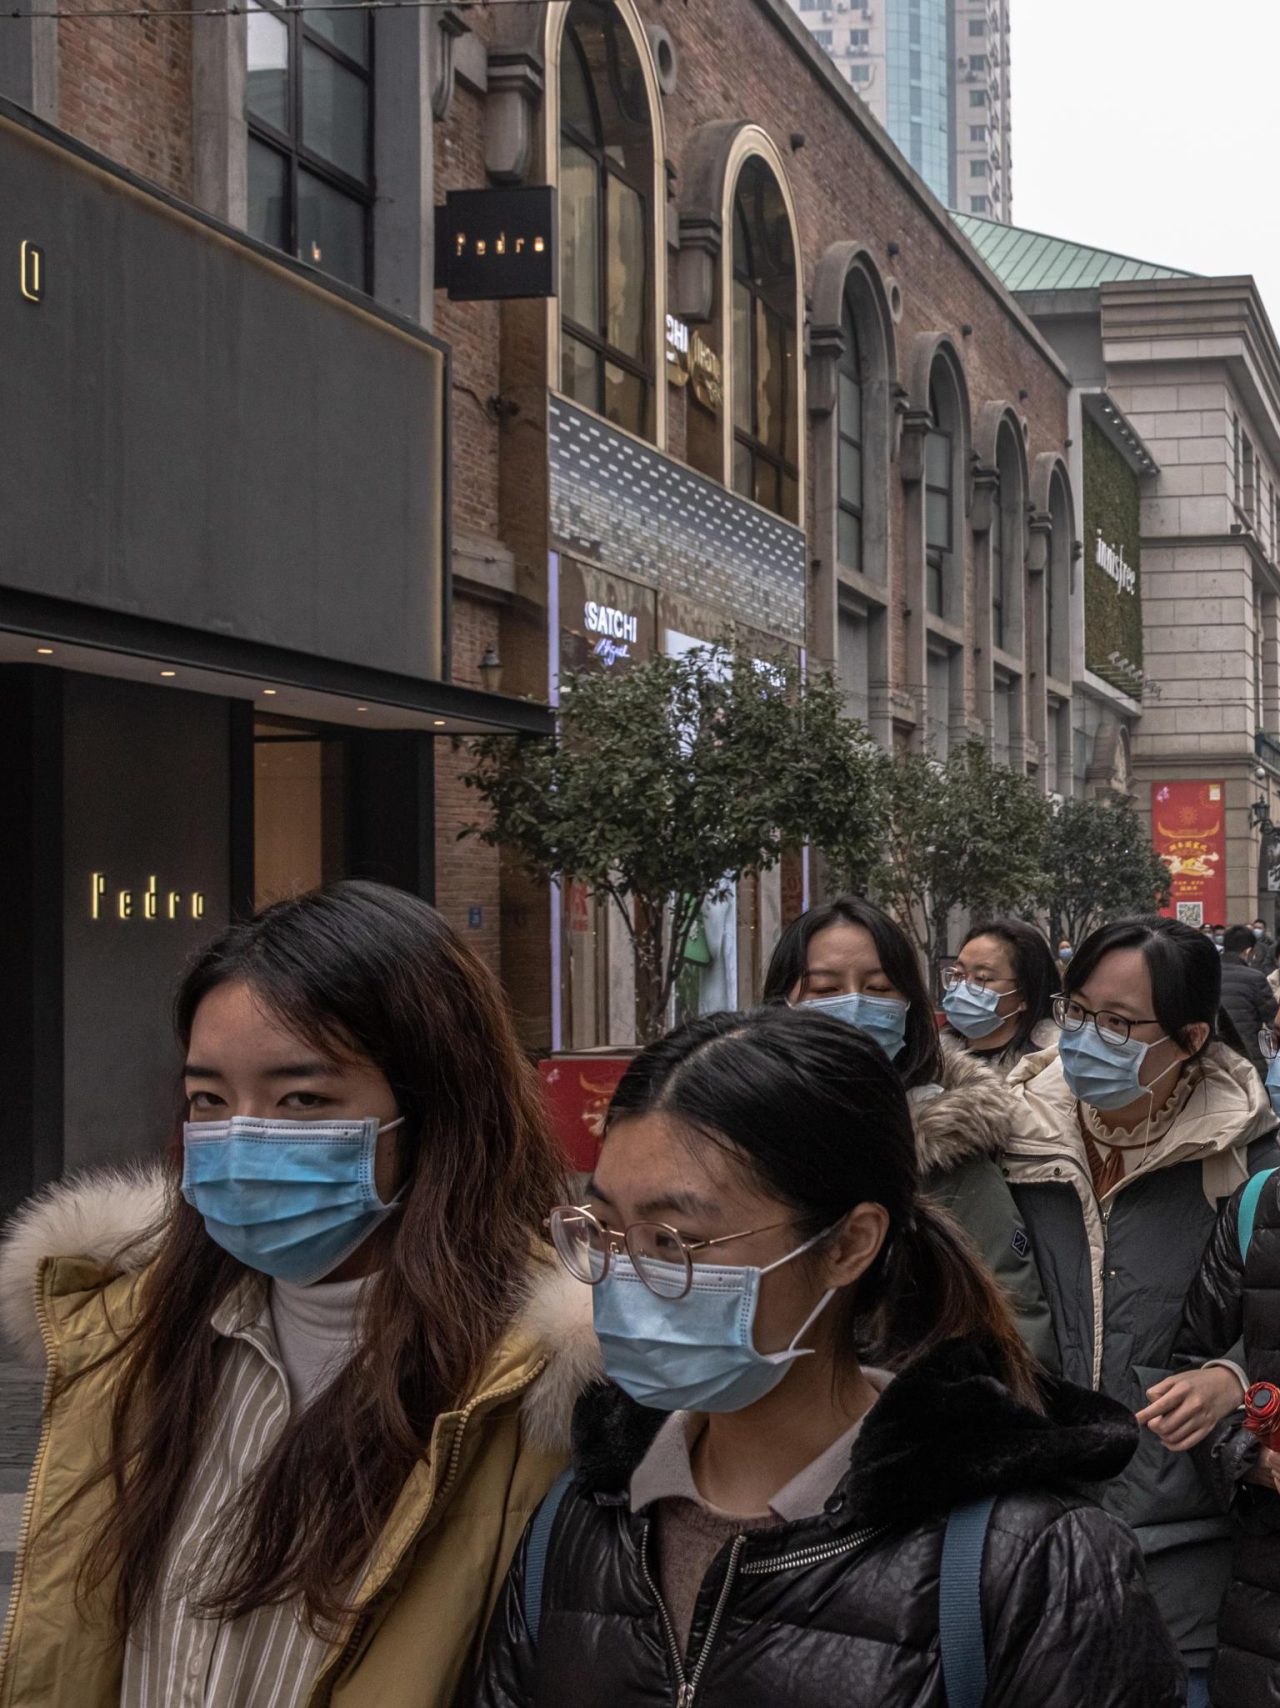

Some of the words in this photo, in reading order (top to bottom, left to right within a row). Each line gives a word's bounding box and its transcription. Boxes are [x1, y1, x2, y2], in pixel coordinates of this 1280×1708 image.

[456, 231, 545, 256] Pedro
[1095, 528, 1137, 596] innisfree
[586, 601, 638, 643] SATCHI
[92, 873, 205, 920] Pedro
